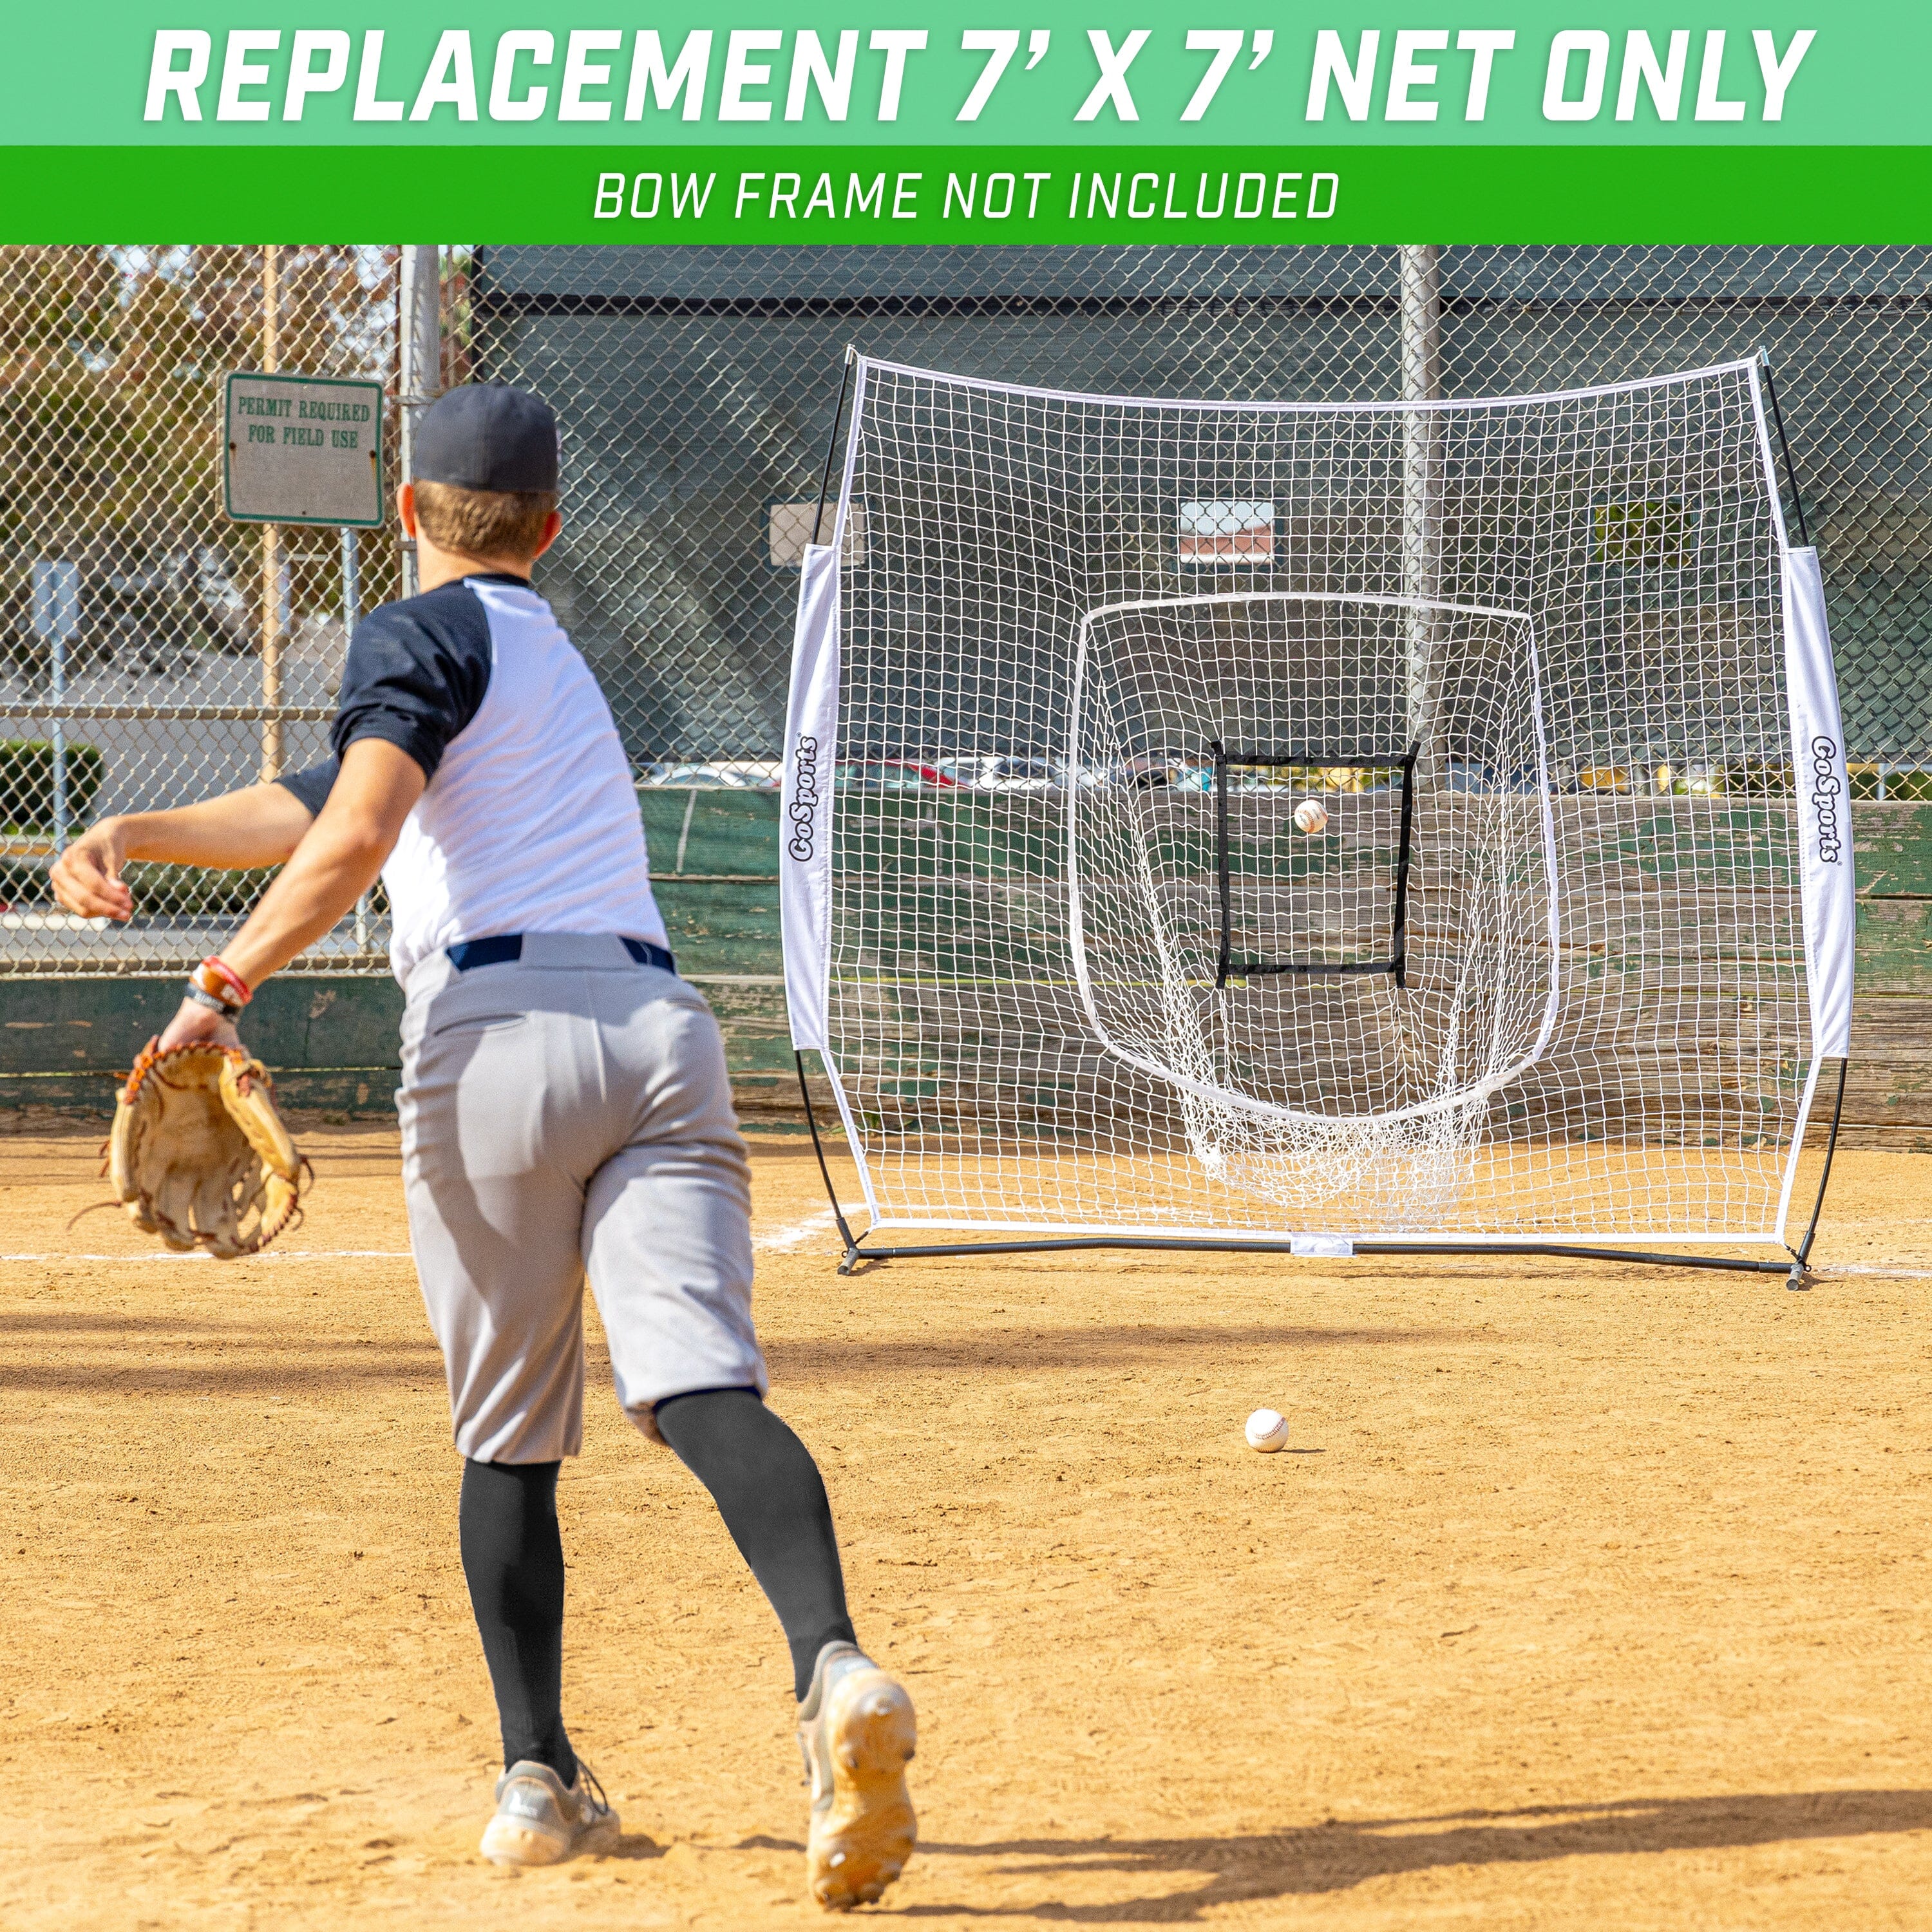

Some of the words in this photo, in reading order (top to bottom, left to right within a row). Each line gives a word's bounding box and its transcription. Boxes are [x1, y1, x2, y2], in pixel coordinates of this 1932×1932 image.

[238, 396, 292, 417] PERMIT
[298, 400, 370, 422] REQUIRED
[247, 424, 275, 444] FOR
[283, 426, 324, 446] FIELD
[331, 430, 358, 449] USE
[788, 735, 819, 862] GoSports
[1811, 735, 1842, 863] GoSports
